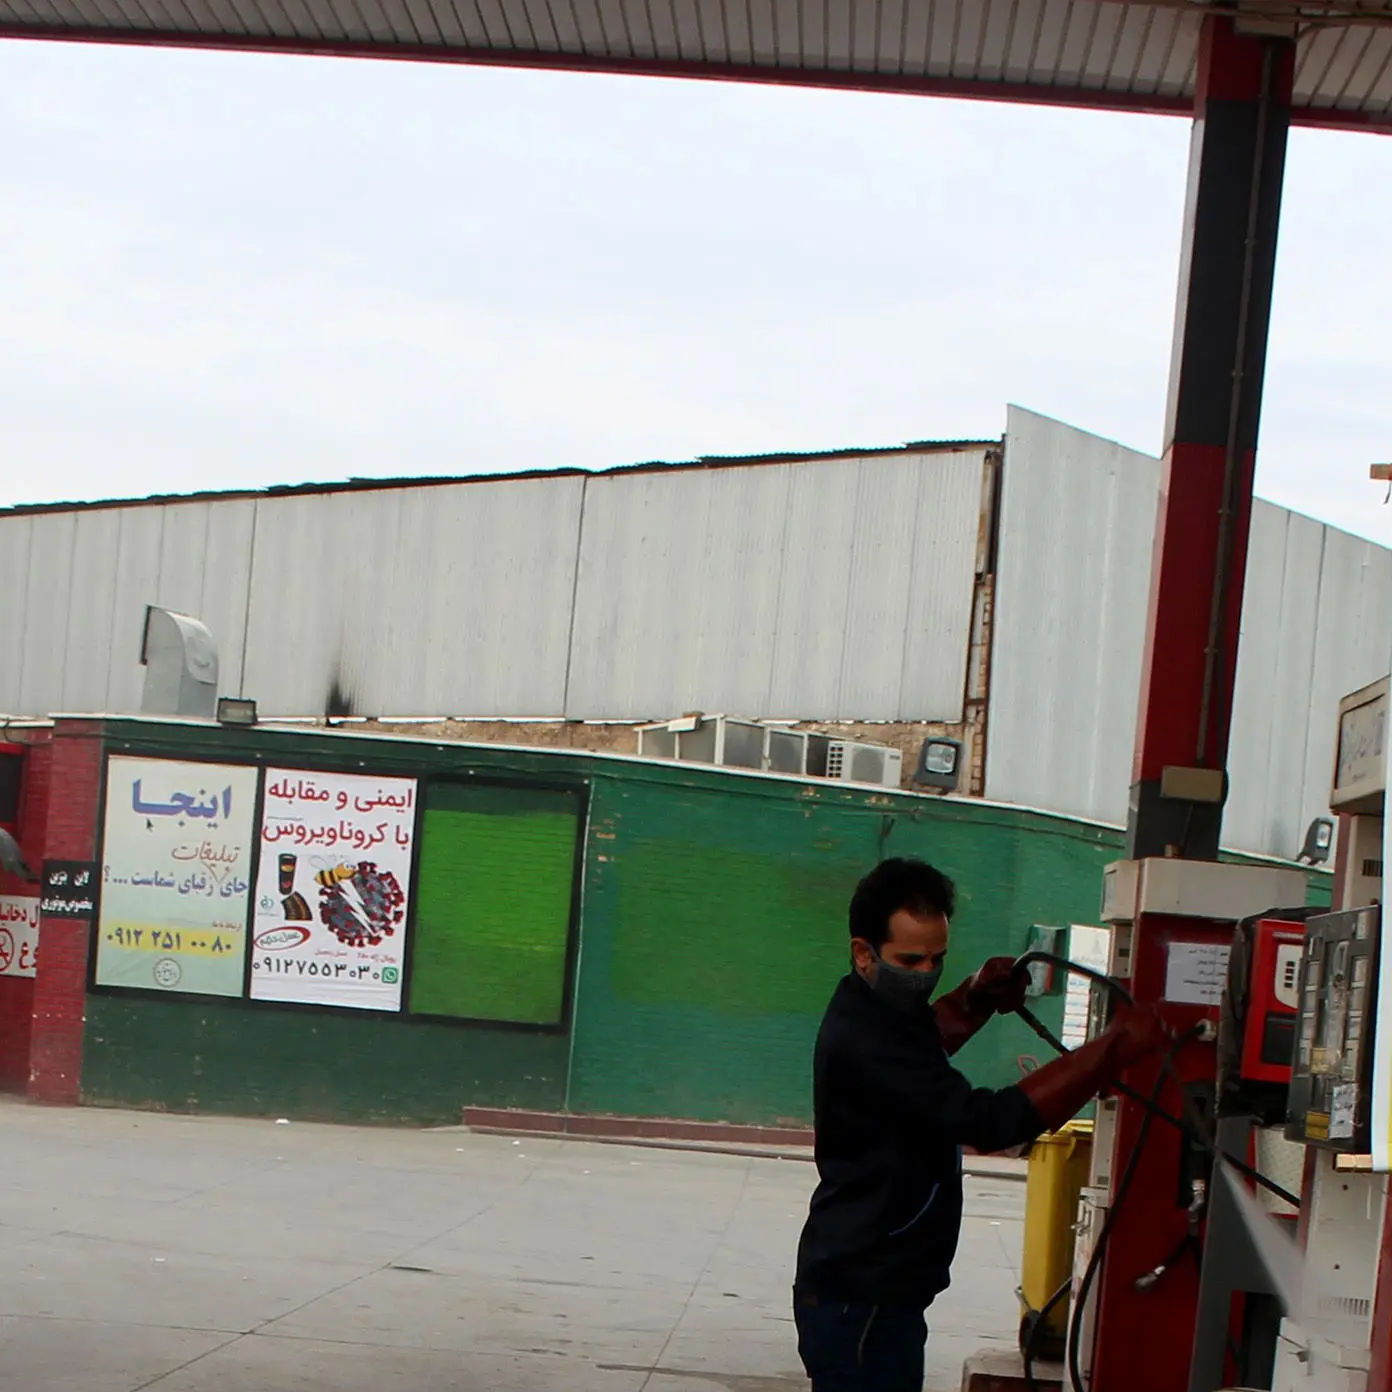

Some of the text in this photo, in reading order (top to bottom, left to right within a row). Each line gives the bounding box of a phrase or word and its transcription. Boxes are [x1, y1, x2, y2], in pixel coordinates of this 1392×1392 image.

[132, 778, 232, 829] اینجا
[268, 778, 412, 813] ایمنی و مقابله
[395, 825, 409, 850] با
[171, 840, 240, 871] تبلیغات
[219, 876, 249, 898] جای
